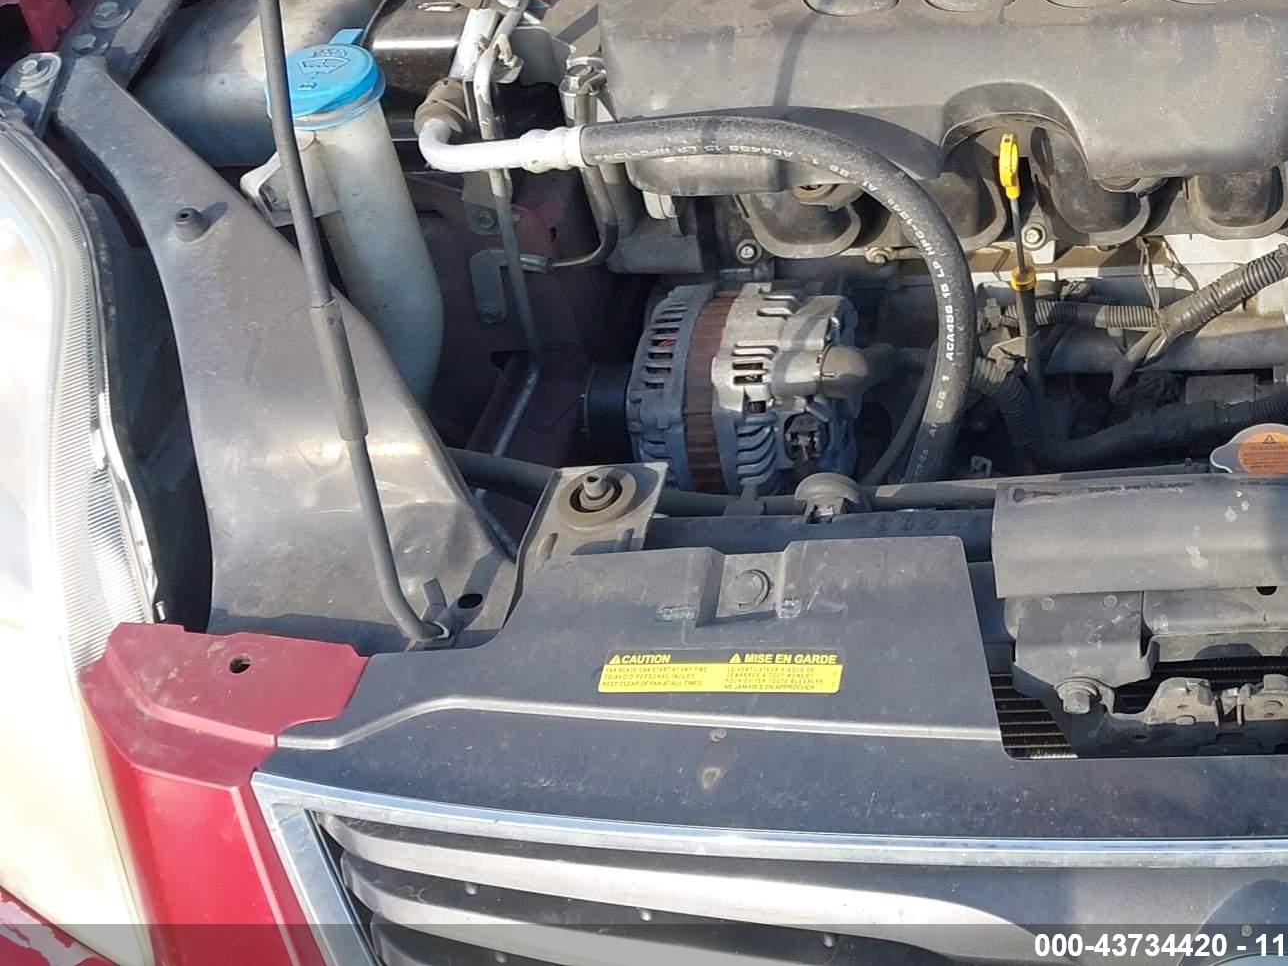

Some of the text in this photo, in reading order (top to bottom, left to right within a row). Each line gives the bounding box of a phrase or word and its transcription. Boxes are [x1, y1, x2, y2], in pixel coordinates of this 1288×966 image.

[621, 654, 672, 664] CAUTION
[744, 653, 838, 665] MISE EN GARDE
